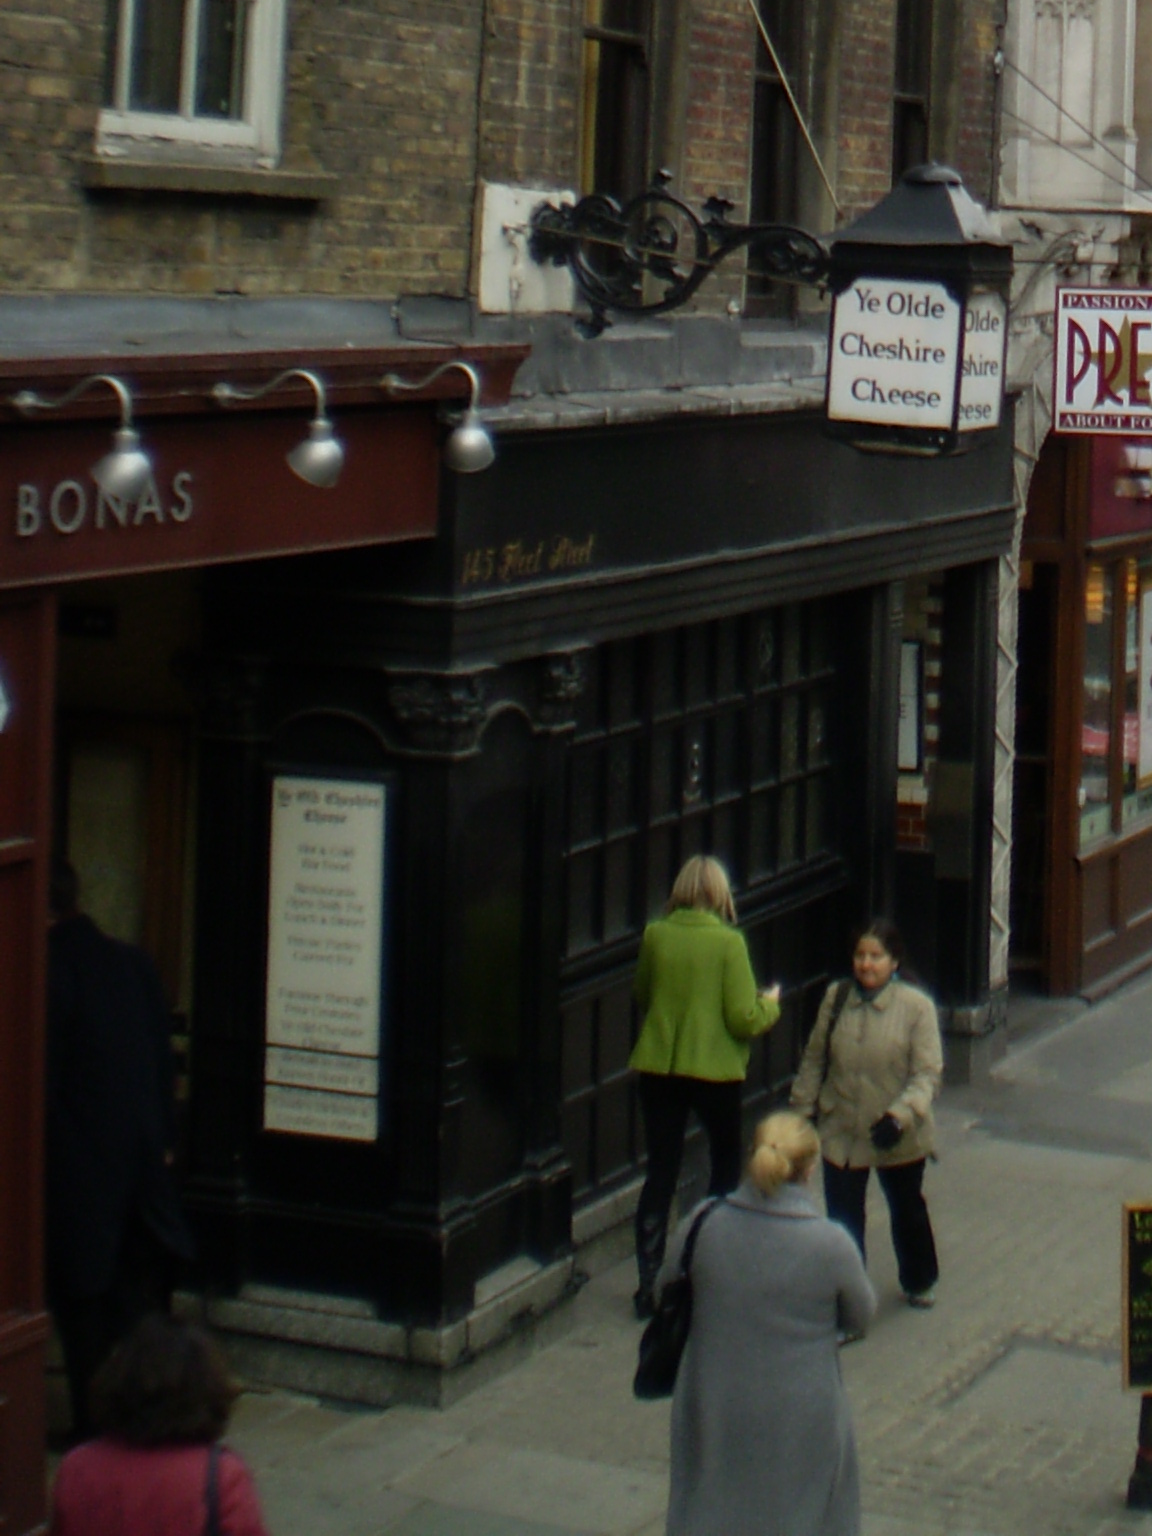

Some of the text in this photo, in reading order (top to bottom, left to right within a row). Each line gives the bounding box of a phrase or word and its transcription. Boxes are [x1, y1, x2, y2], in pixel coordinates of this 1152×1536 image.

[855, 288, 945, 319] Ye Olde
[839, 331, 946, 363] Cheshire
[962, 354, 999, 377] shire
[851, 377, 942, 408] Cheese
[959, 403, 992, 420] eese
[1063, 413, 1127, 430] ABOUT
[17, 472, 194, 537] BONAS
